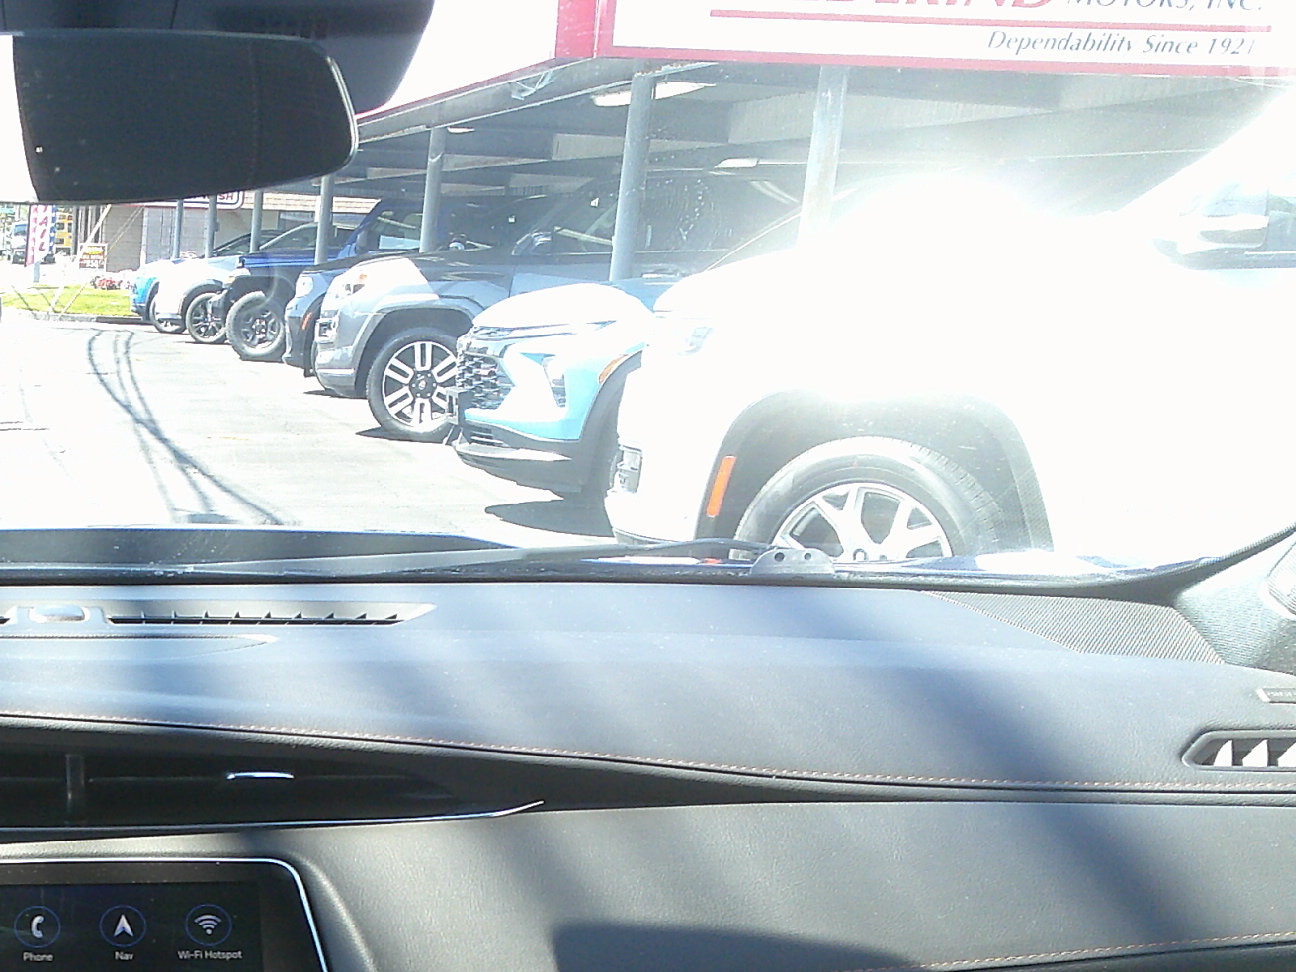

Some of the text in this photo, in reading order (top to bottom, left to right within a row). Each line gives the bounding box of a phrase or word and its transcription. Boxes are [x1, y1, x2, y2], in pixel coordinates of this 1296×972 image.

[988, 31, 1135, 56] Dependability
[1143, 34, 1198, 54] Since
[22, 952, 54, 962] Phone
[114, 951, 134, 960] Nav
[178, 950, 242, 961] Wi-Fi Hotspot
